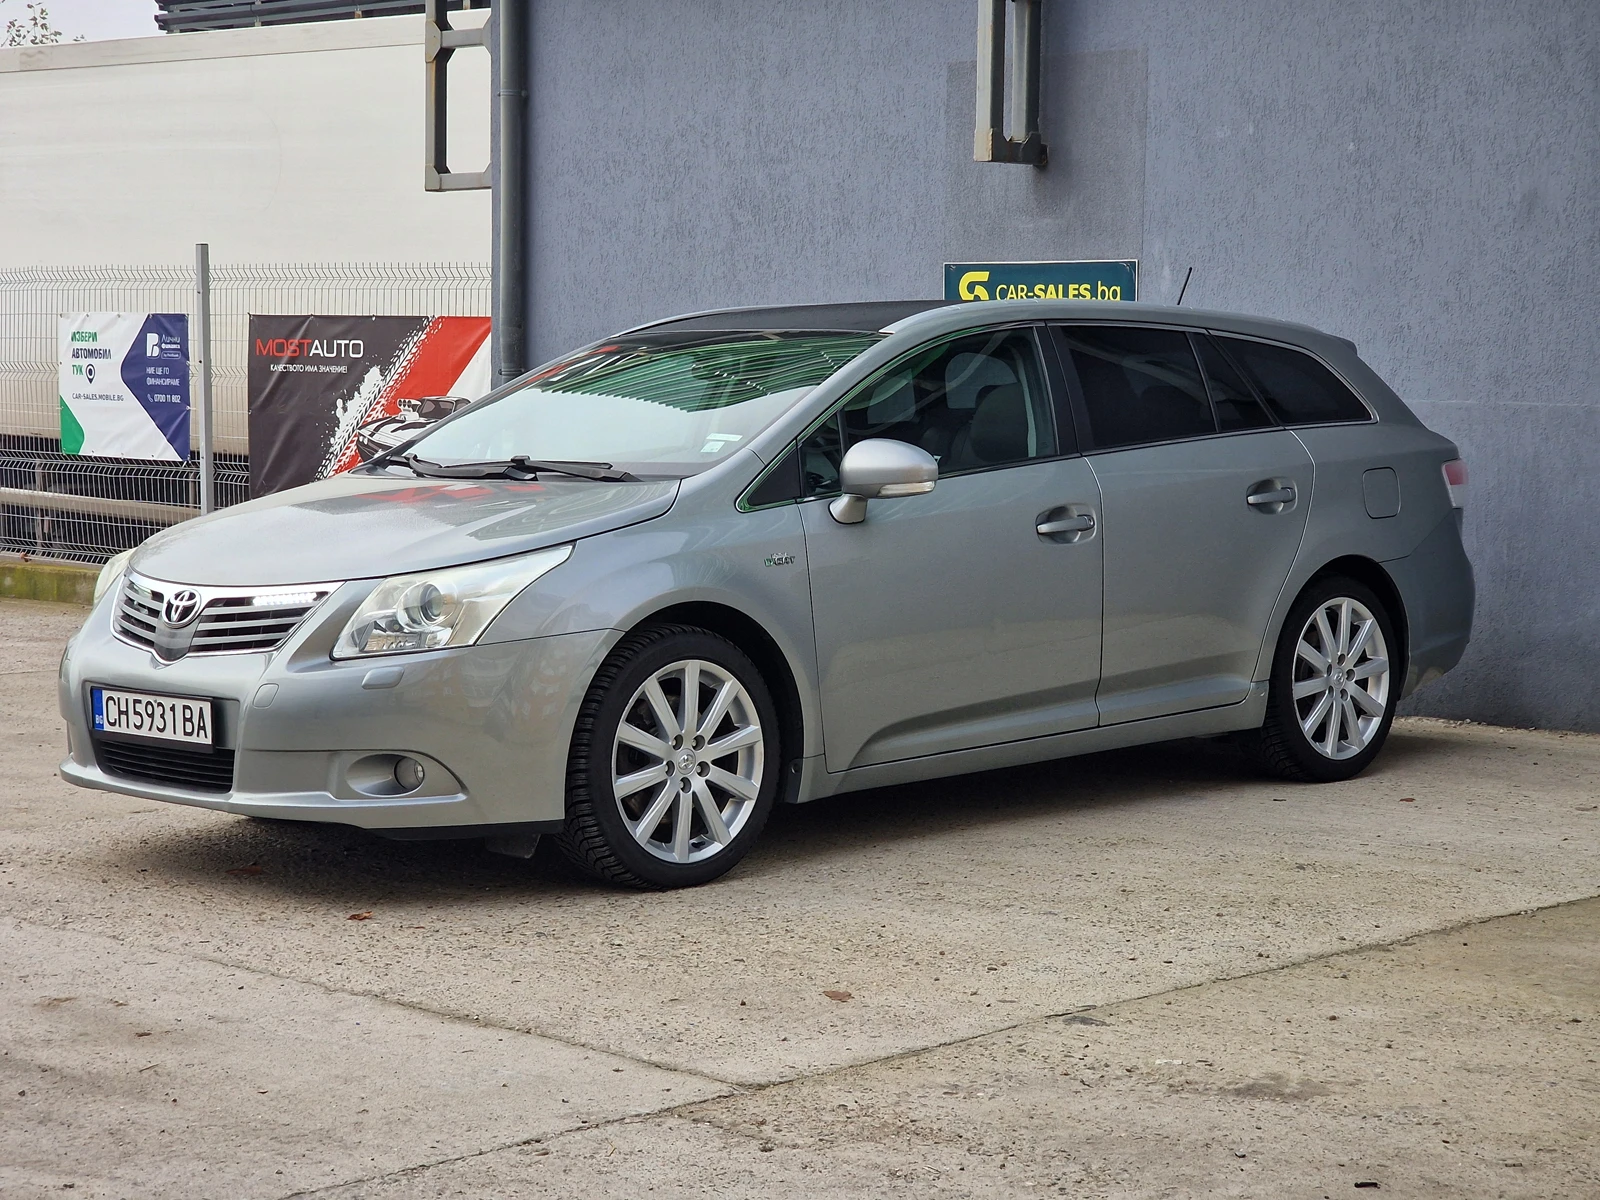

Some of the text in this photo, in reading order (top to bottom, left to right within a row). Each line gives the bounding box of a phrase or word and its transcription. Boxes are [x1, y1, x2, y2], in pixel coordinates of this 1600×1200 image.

[71, 331, 97, 342] ИЗБЕРИ
[255, 338, 364, 358] MOSTAUTO
[72, 348, 111, 359] АВТОМОБИЛ
[72, 365, 83, 375] ТУК
[146, 366, 155, 375] НИЕ
[270, 364, 304, 372] КАЧЕСТВОТО
[305, 364, 318, 372] ИМА
[146, 377, 180, 386] ФИНАНСИРАМЕ
[72, 393, 124, 401] CAR-SALES.MOBILE.BG
[154, 394, 166, 402] 0700
[166, 394, 171, 402] 11
